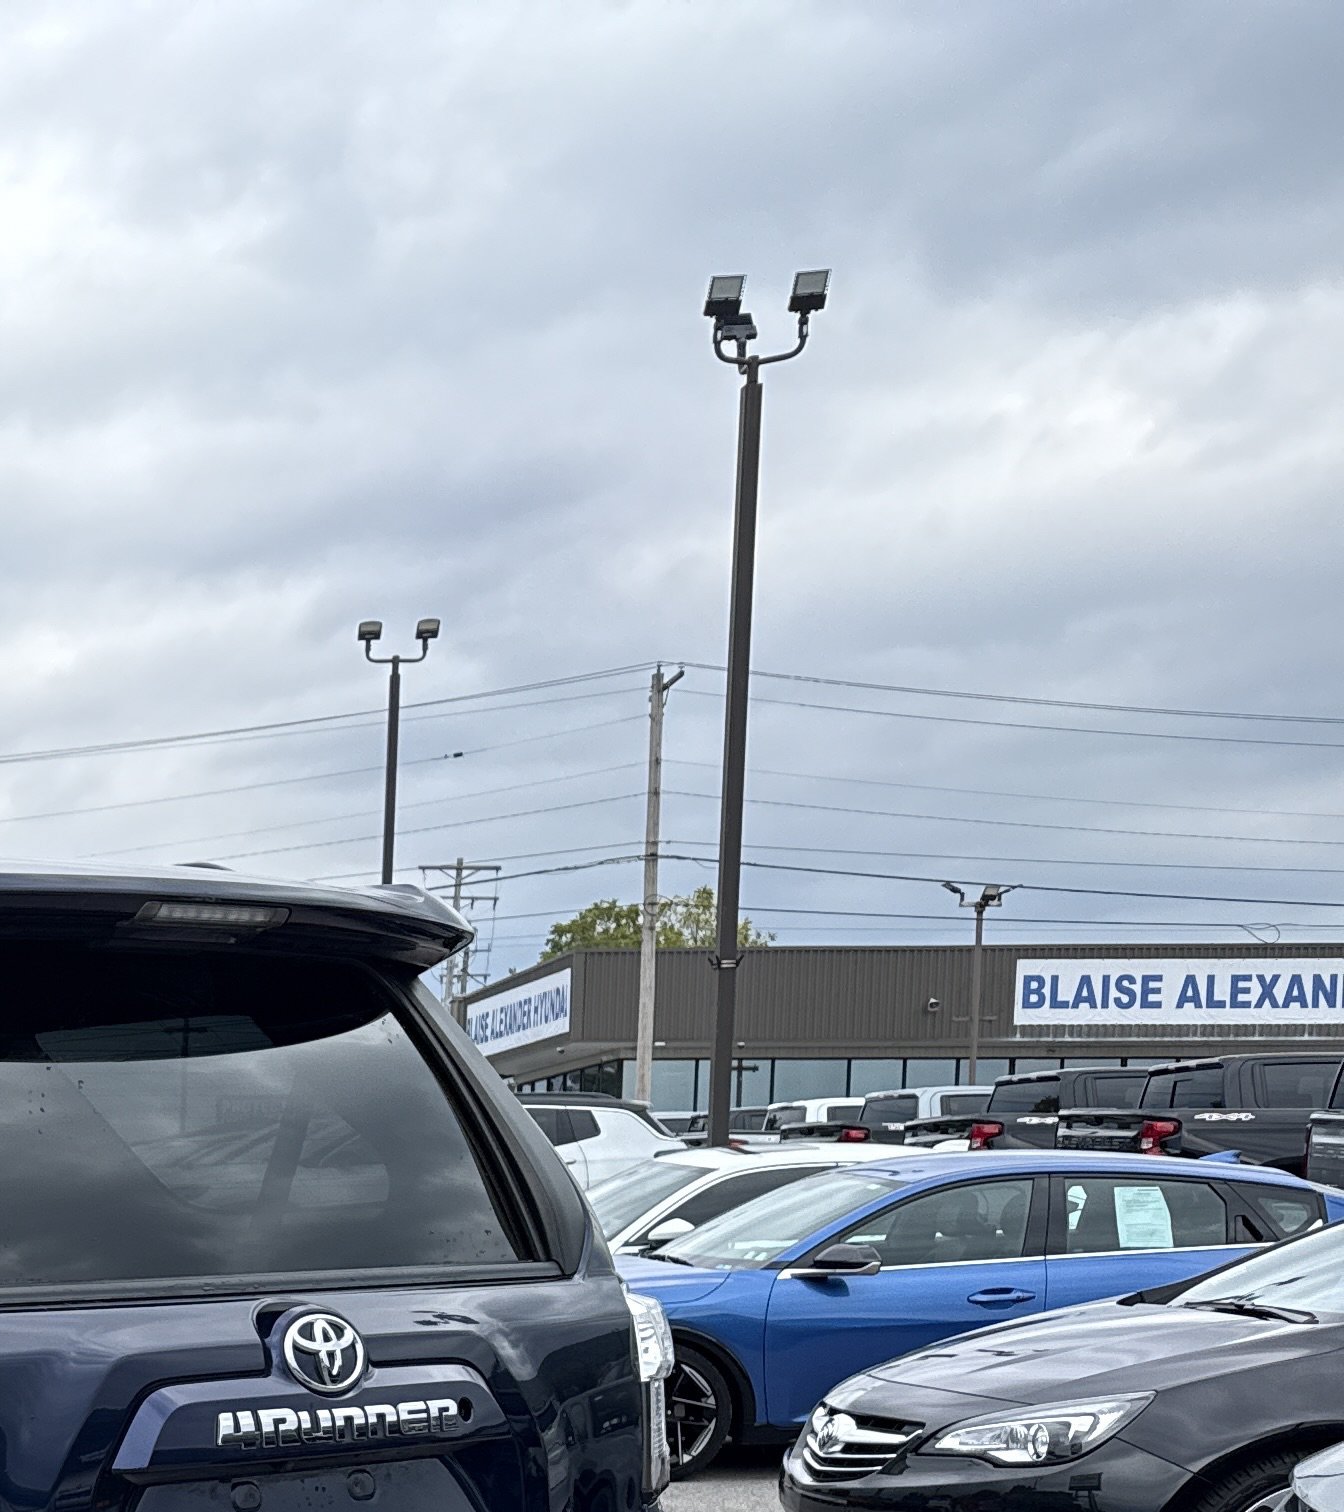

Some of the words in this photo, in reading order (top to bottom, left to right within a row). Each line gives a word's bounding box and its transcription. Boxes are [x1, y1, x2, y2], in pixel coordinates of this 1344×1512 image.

[490, 997, 532, 1041] ALEXANDER
[533, 984, 568, 1028] HYUNDAI
[1022, 974, 1164, 1009] BLAISE
[1175, 973, 1344, 1009] ALEXAN
